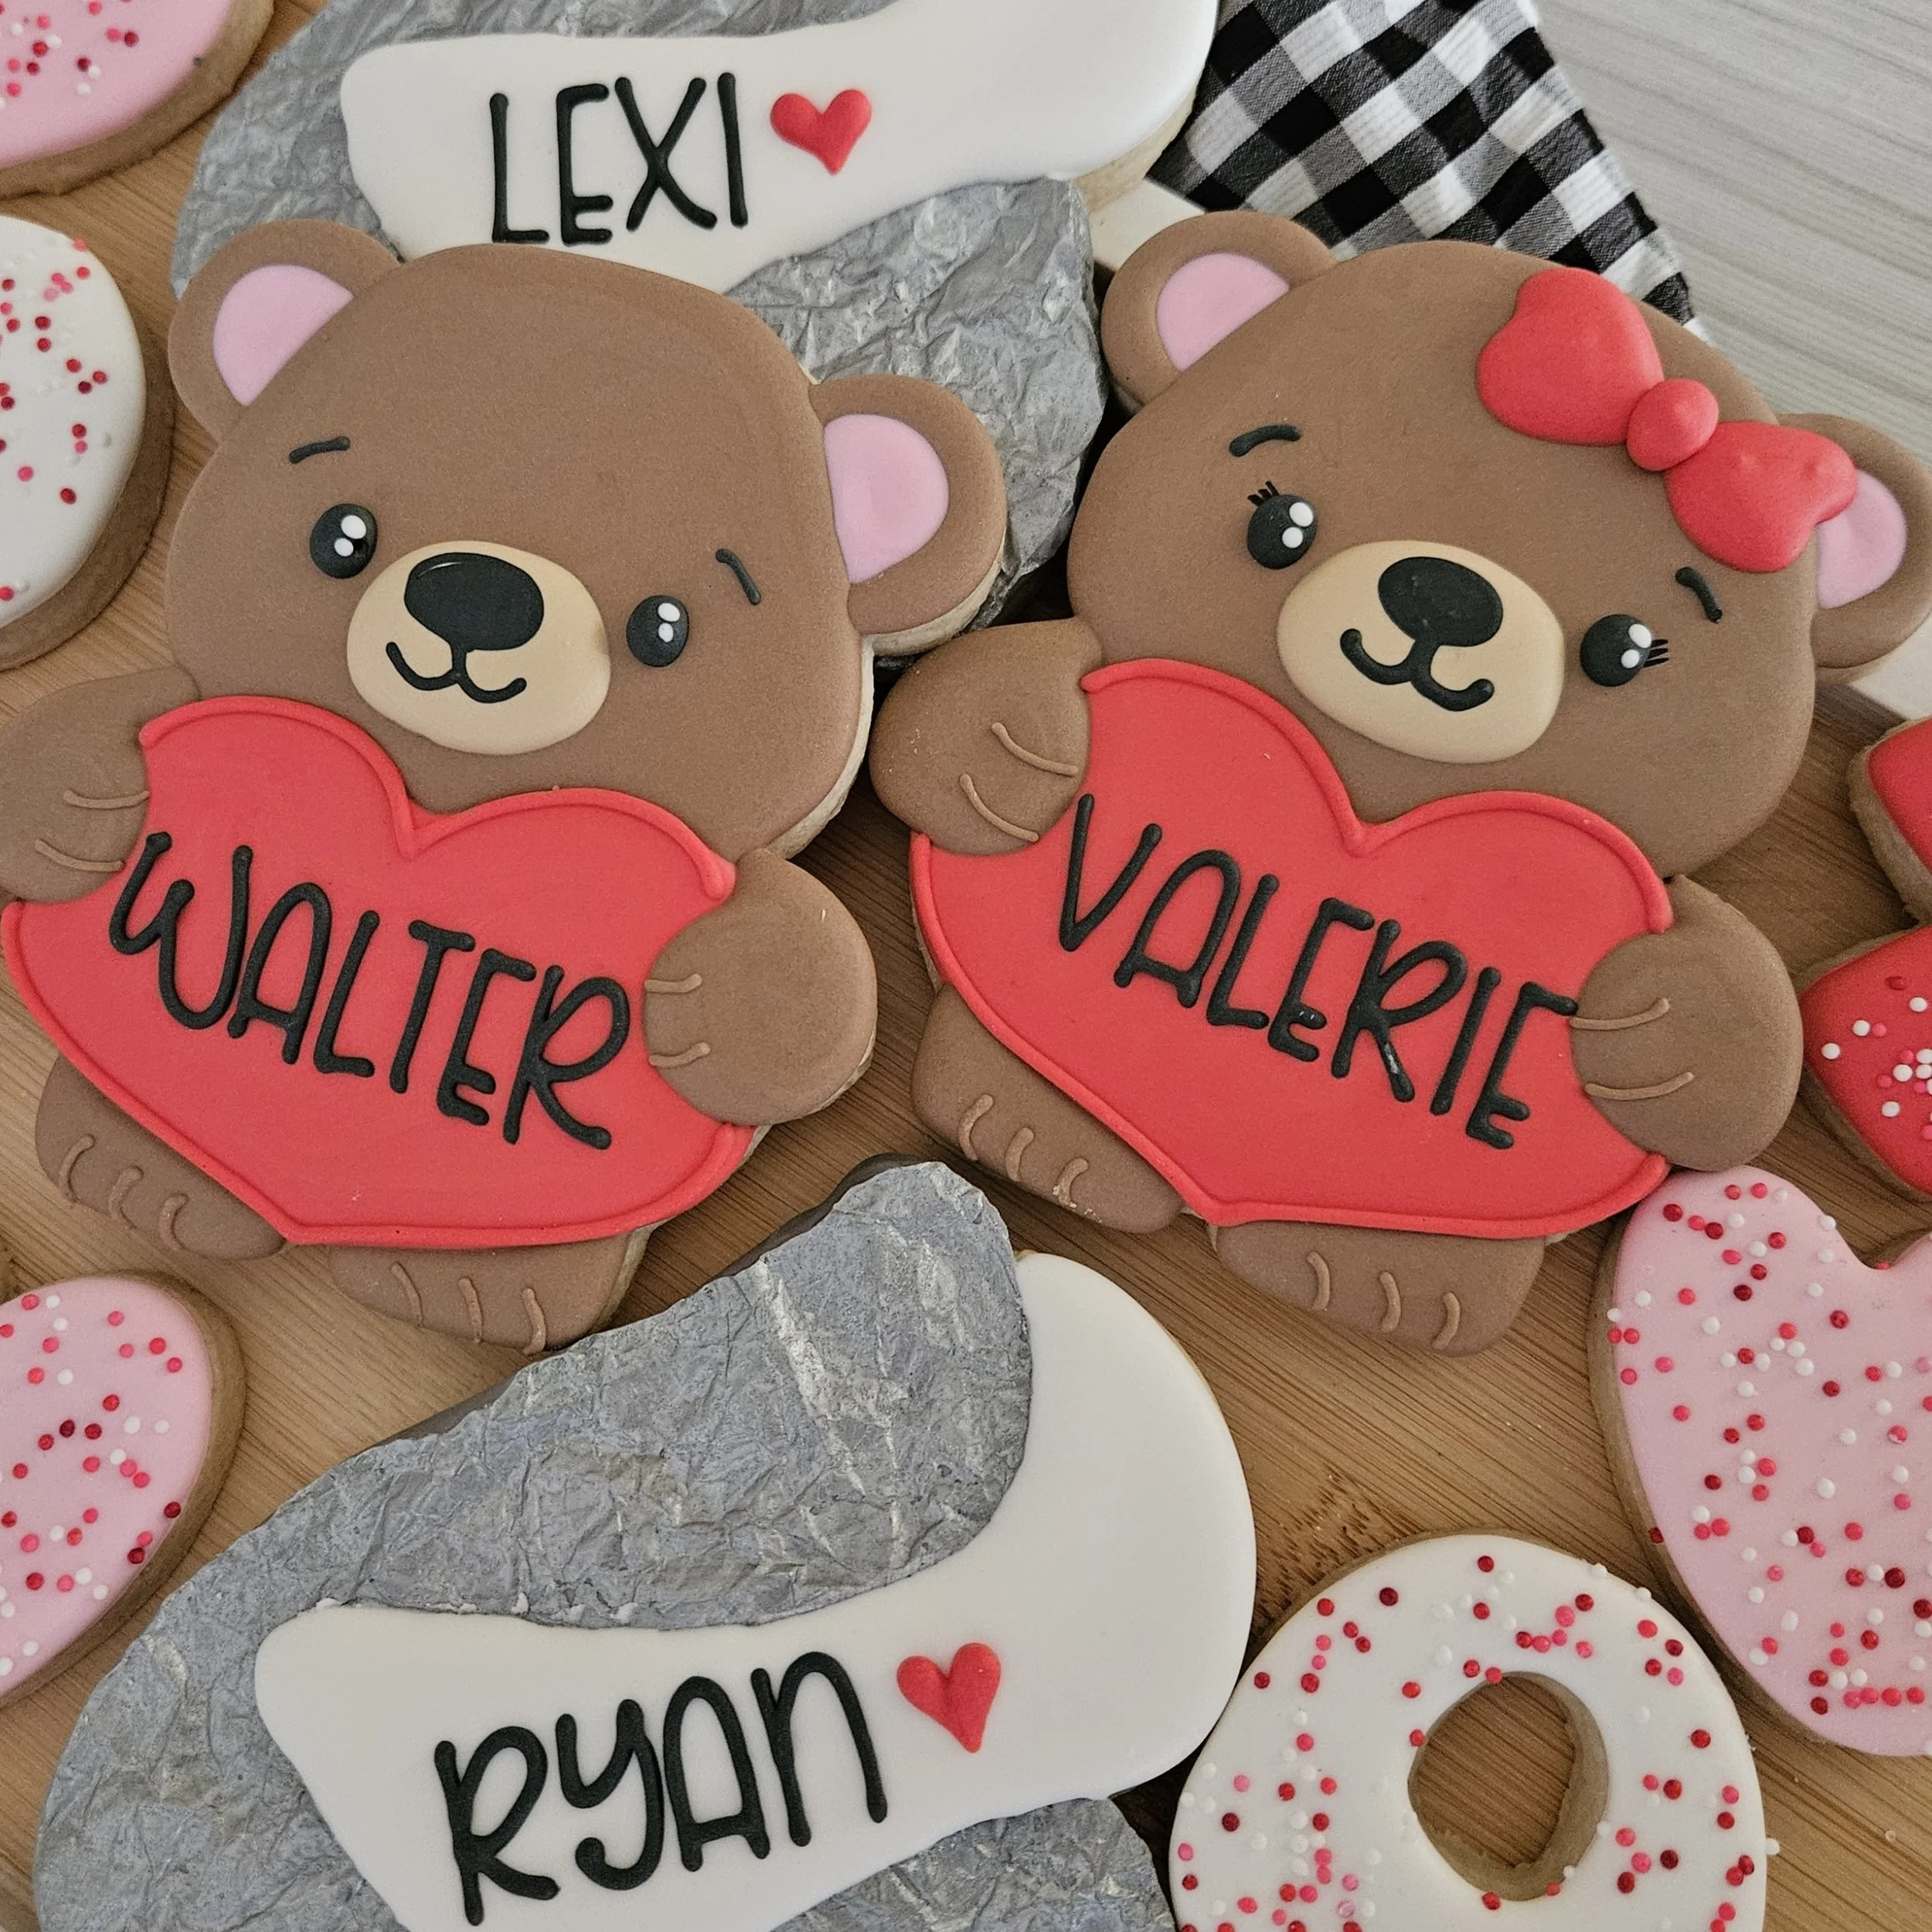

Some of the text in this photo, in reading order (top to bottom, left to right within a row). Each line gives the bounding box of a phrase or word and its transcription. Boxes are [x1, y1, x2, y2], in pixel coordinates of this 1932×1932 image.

[490, 73, 747, 244] LEXI
[110, 832, 630, 1149] WALTER
[1060, 793, 1580, 1149] VALERIE
